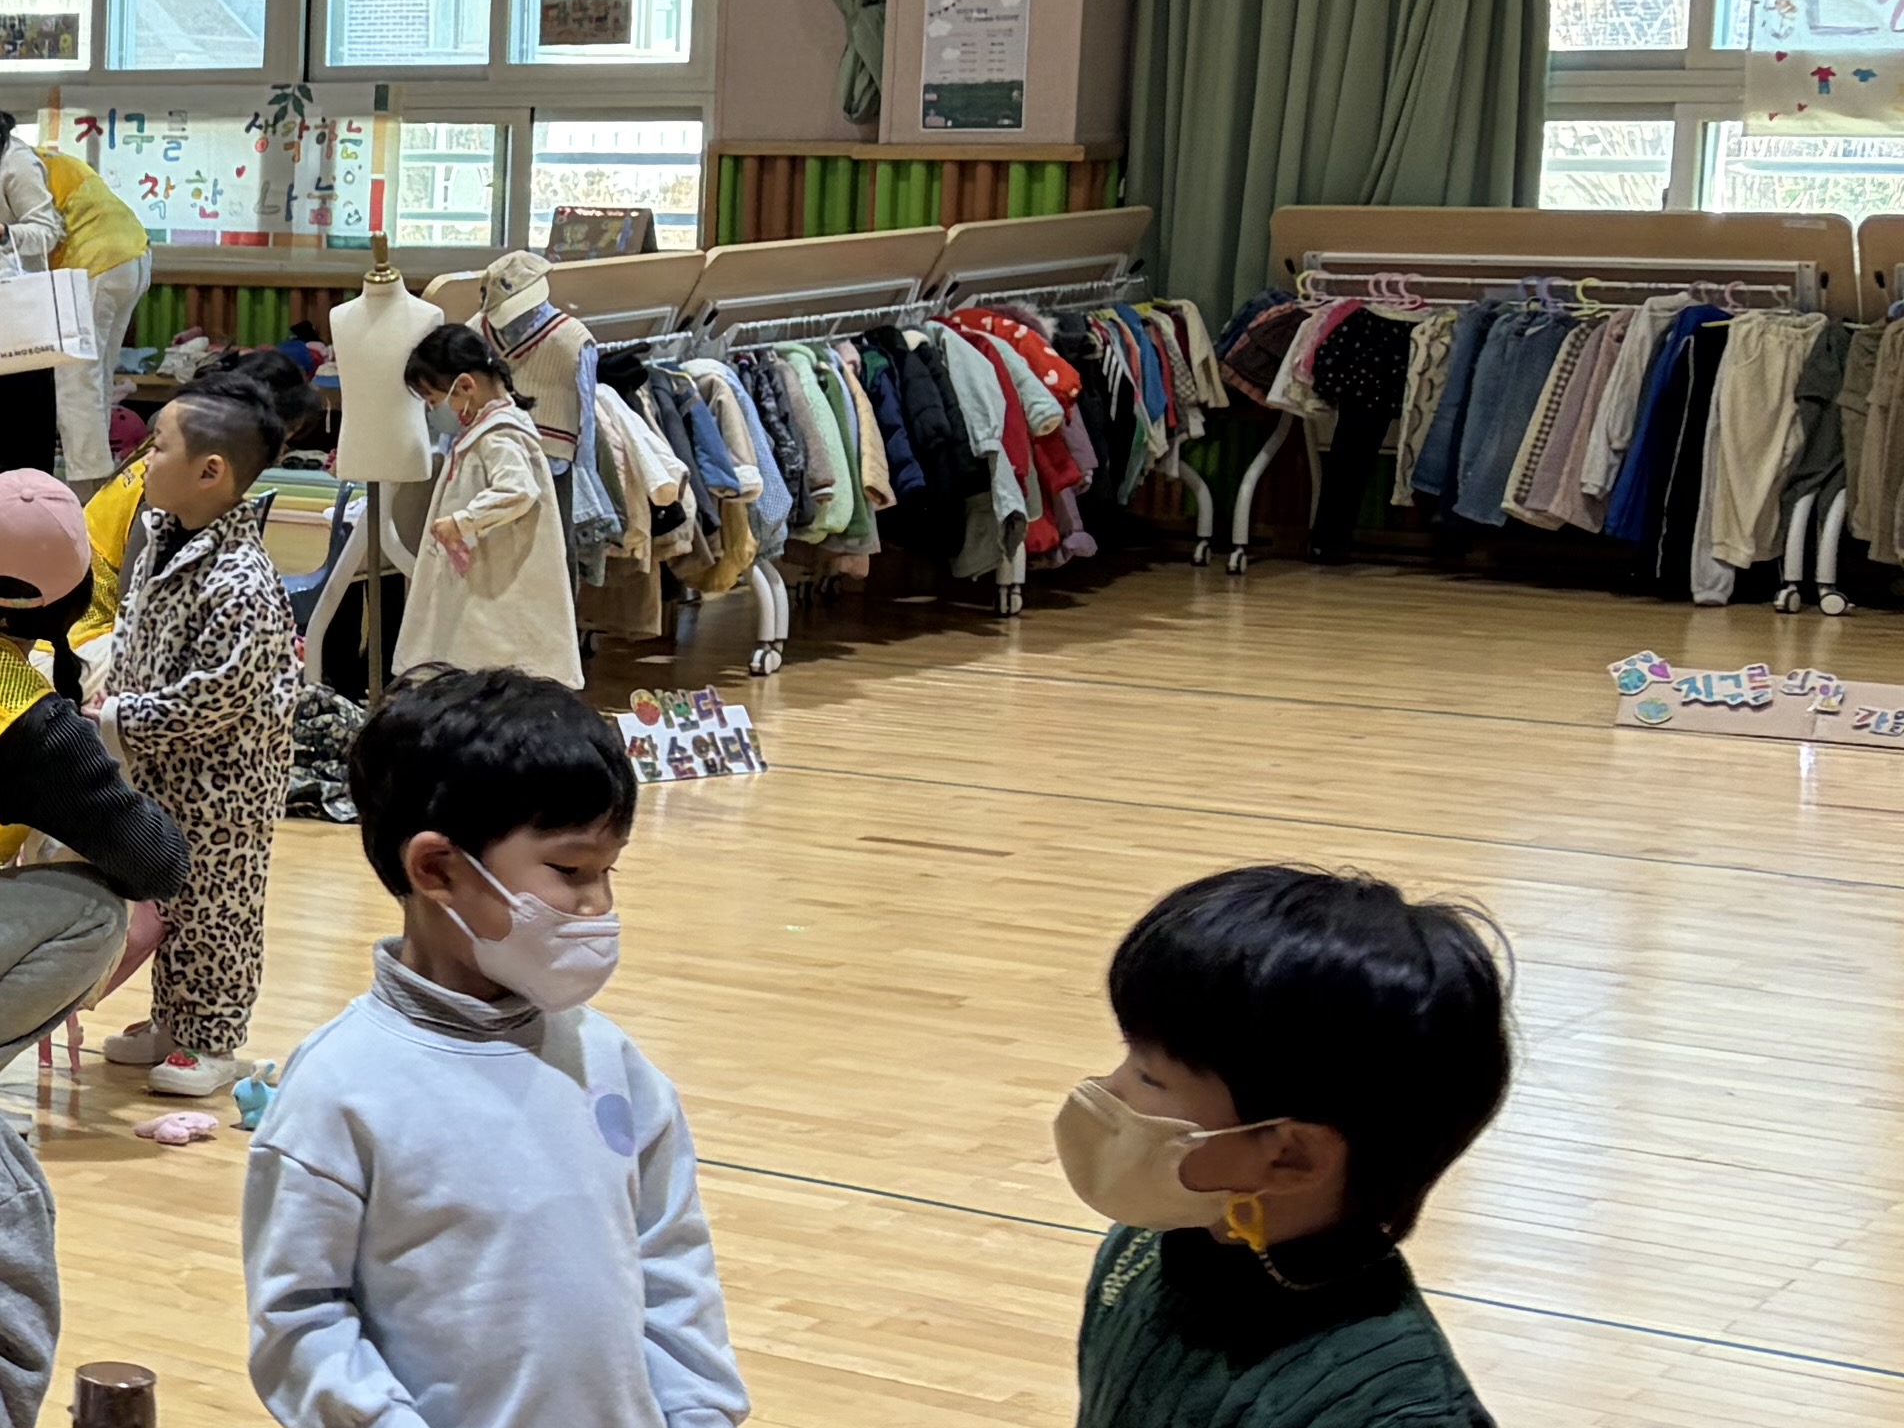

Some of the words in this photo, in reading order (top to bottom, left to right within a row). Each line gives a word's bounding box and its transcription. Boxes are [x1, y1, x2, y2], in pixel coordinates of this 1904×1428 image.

[74, 108, 190, 163] 지구를
[244, 110, 364, 164] 생각하는
[138, 169, 224, 221] 착한
[254, 175, 338, 227] 나눔
[629, 684, 729, 732] 이보다
